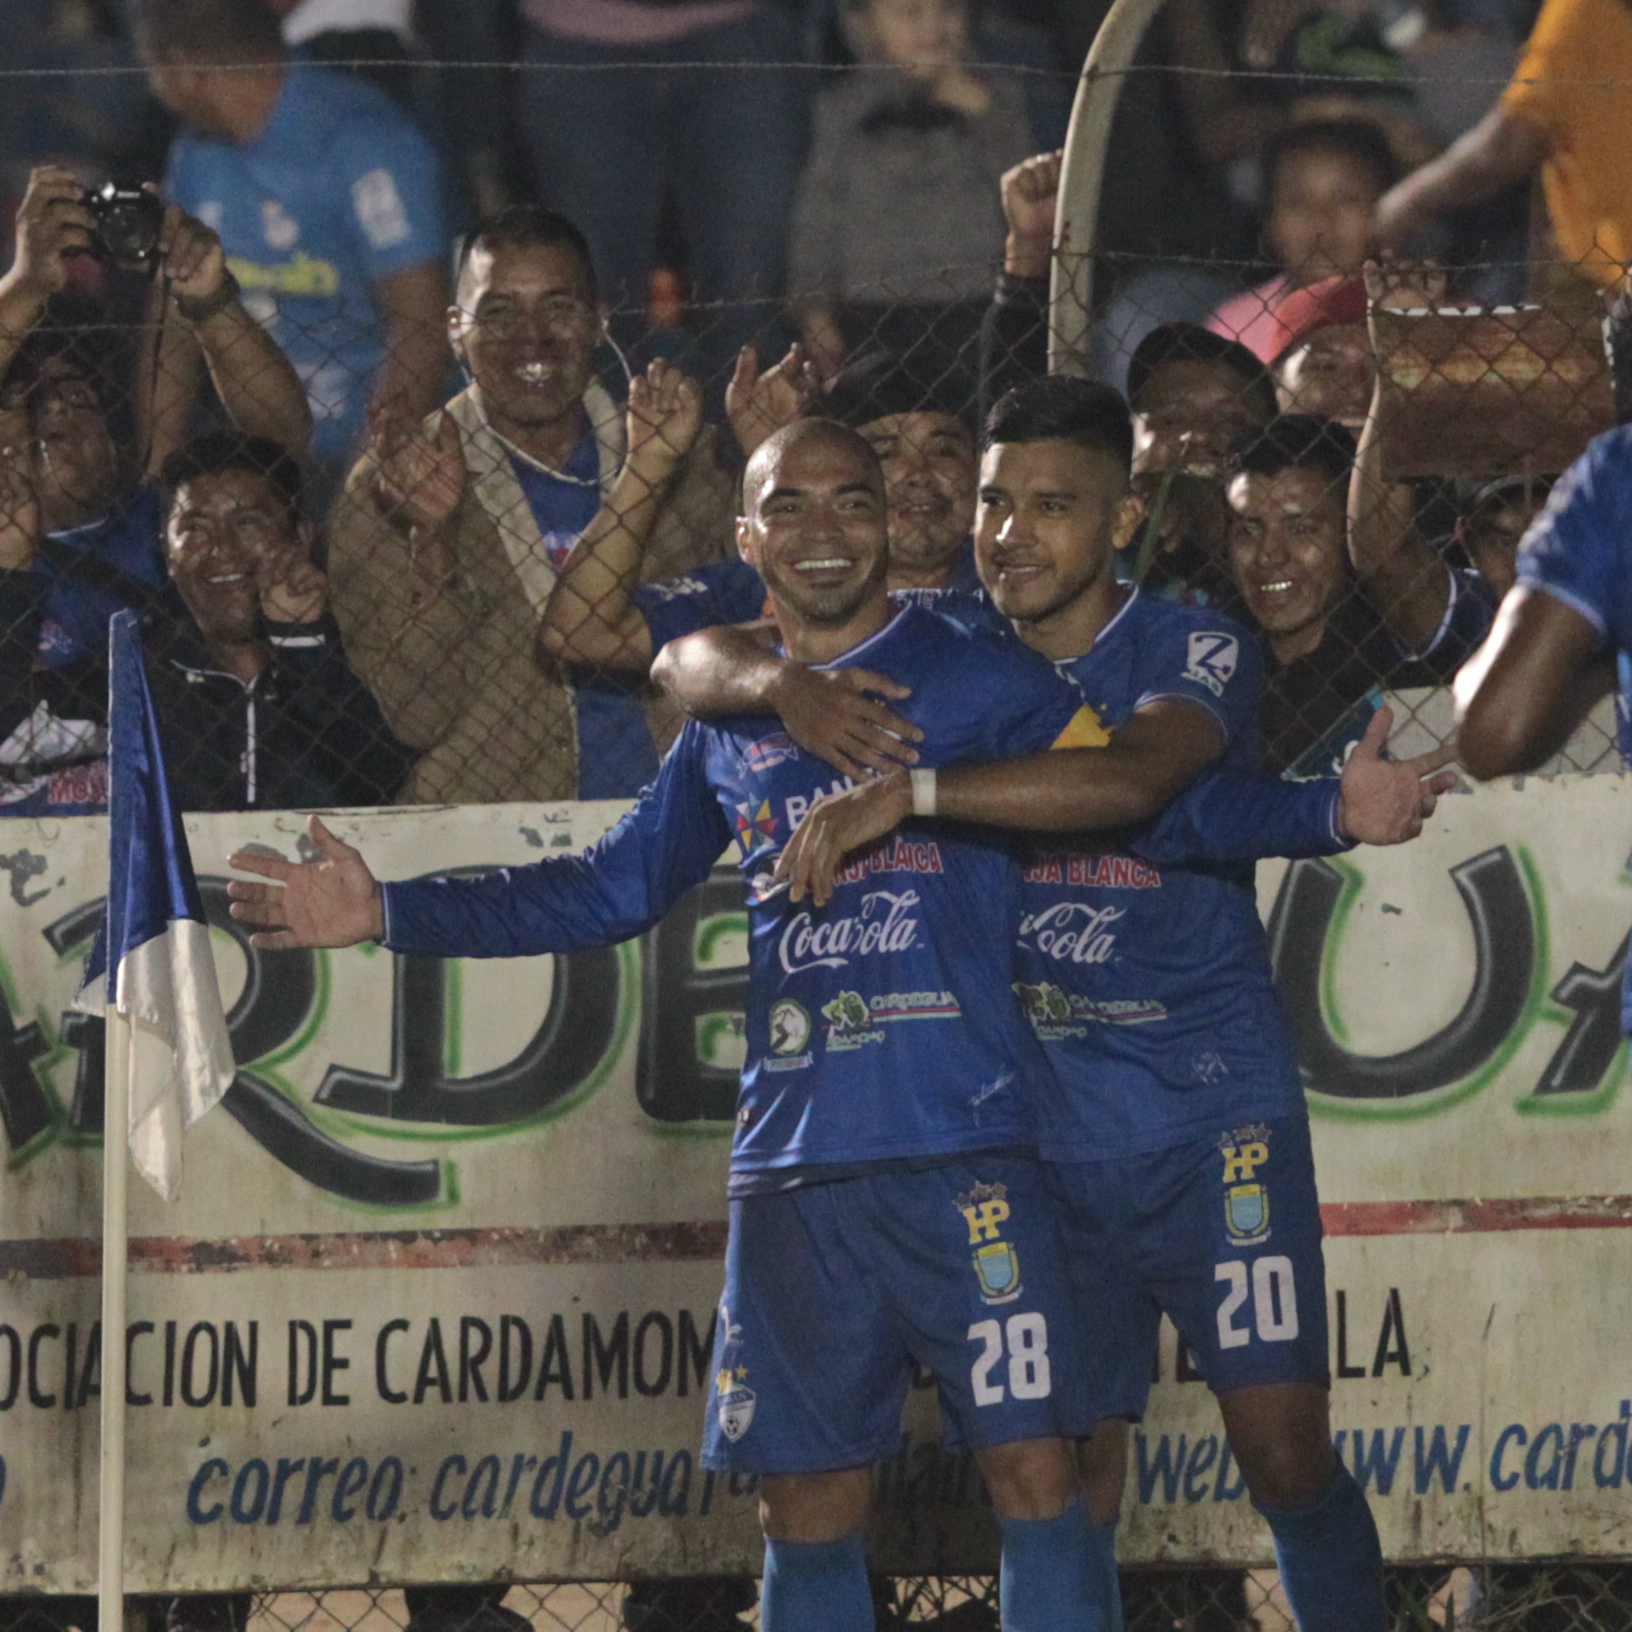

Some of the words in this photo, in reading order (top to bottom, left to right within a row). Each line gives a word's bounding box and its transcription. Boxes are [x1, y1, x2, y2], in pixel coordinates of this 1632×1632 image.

[1214, 1255, 1300, 1349] 20
[287, 1318, 354, 1407] DE
[966, 1311, 1052, 1408] 28
